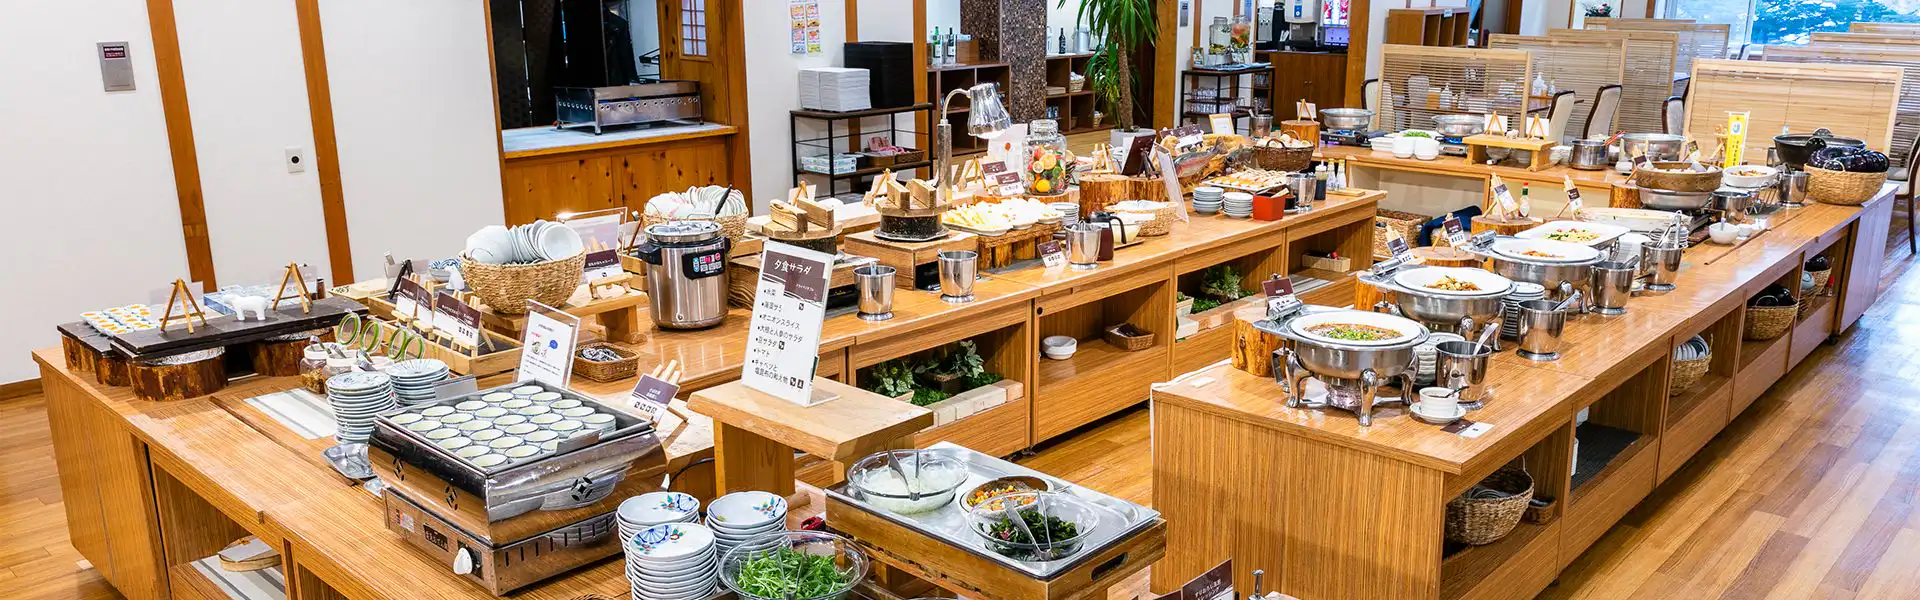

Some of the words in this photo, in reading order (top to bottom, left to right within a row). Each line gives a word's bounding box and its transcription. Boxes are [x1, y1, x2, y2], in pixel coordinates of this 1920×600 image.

[774, 259, 812, 275] 夕食サラダ
[762, 314, 800, 331] オニオンスライス
[757, 348, 770, 358] トマト
[755, 359, 777, 372] キャベツと
